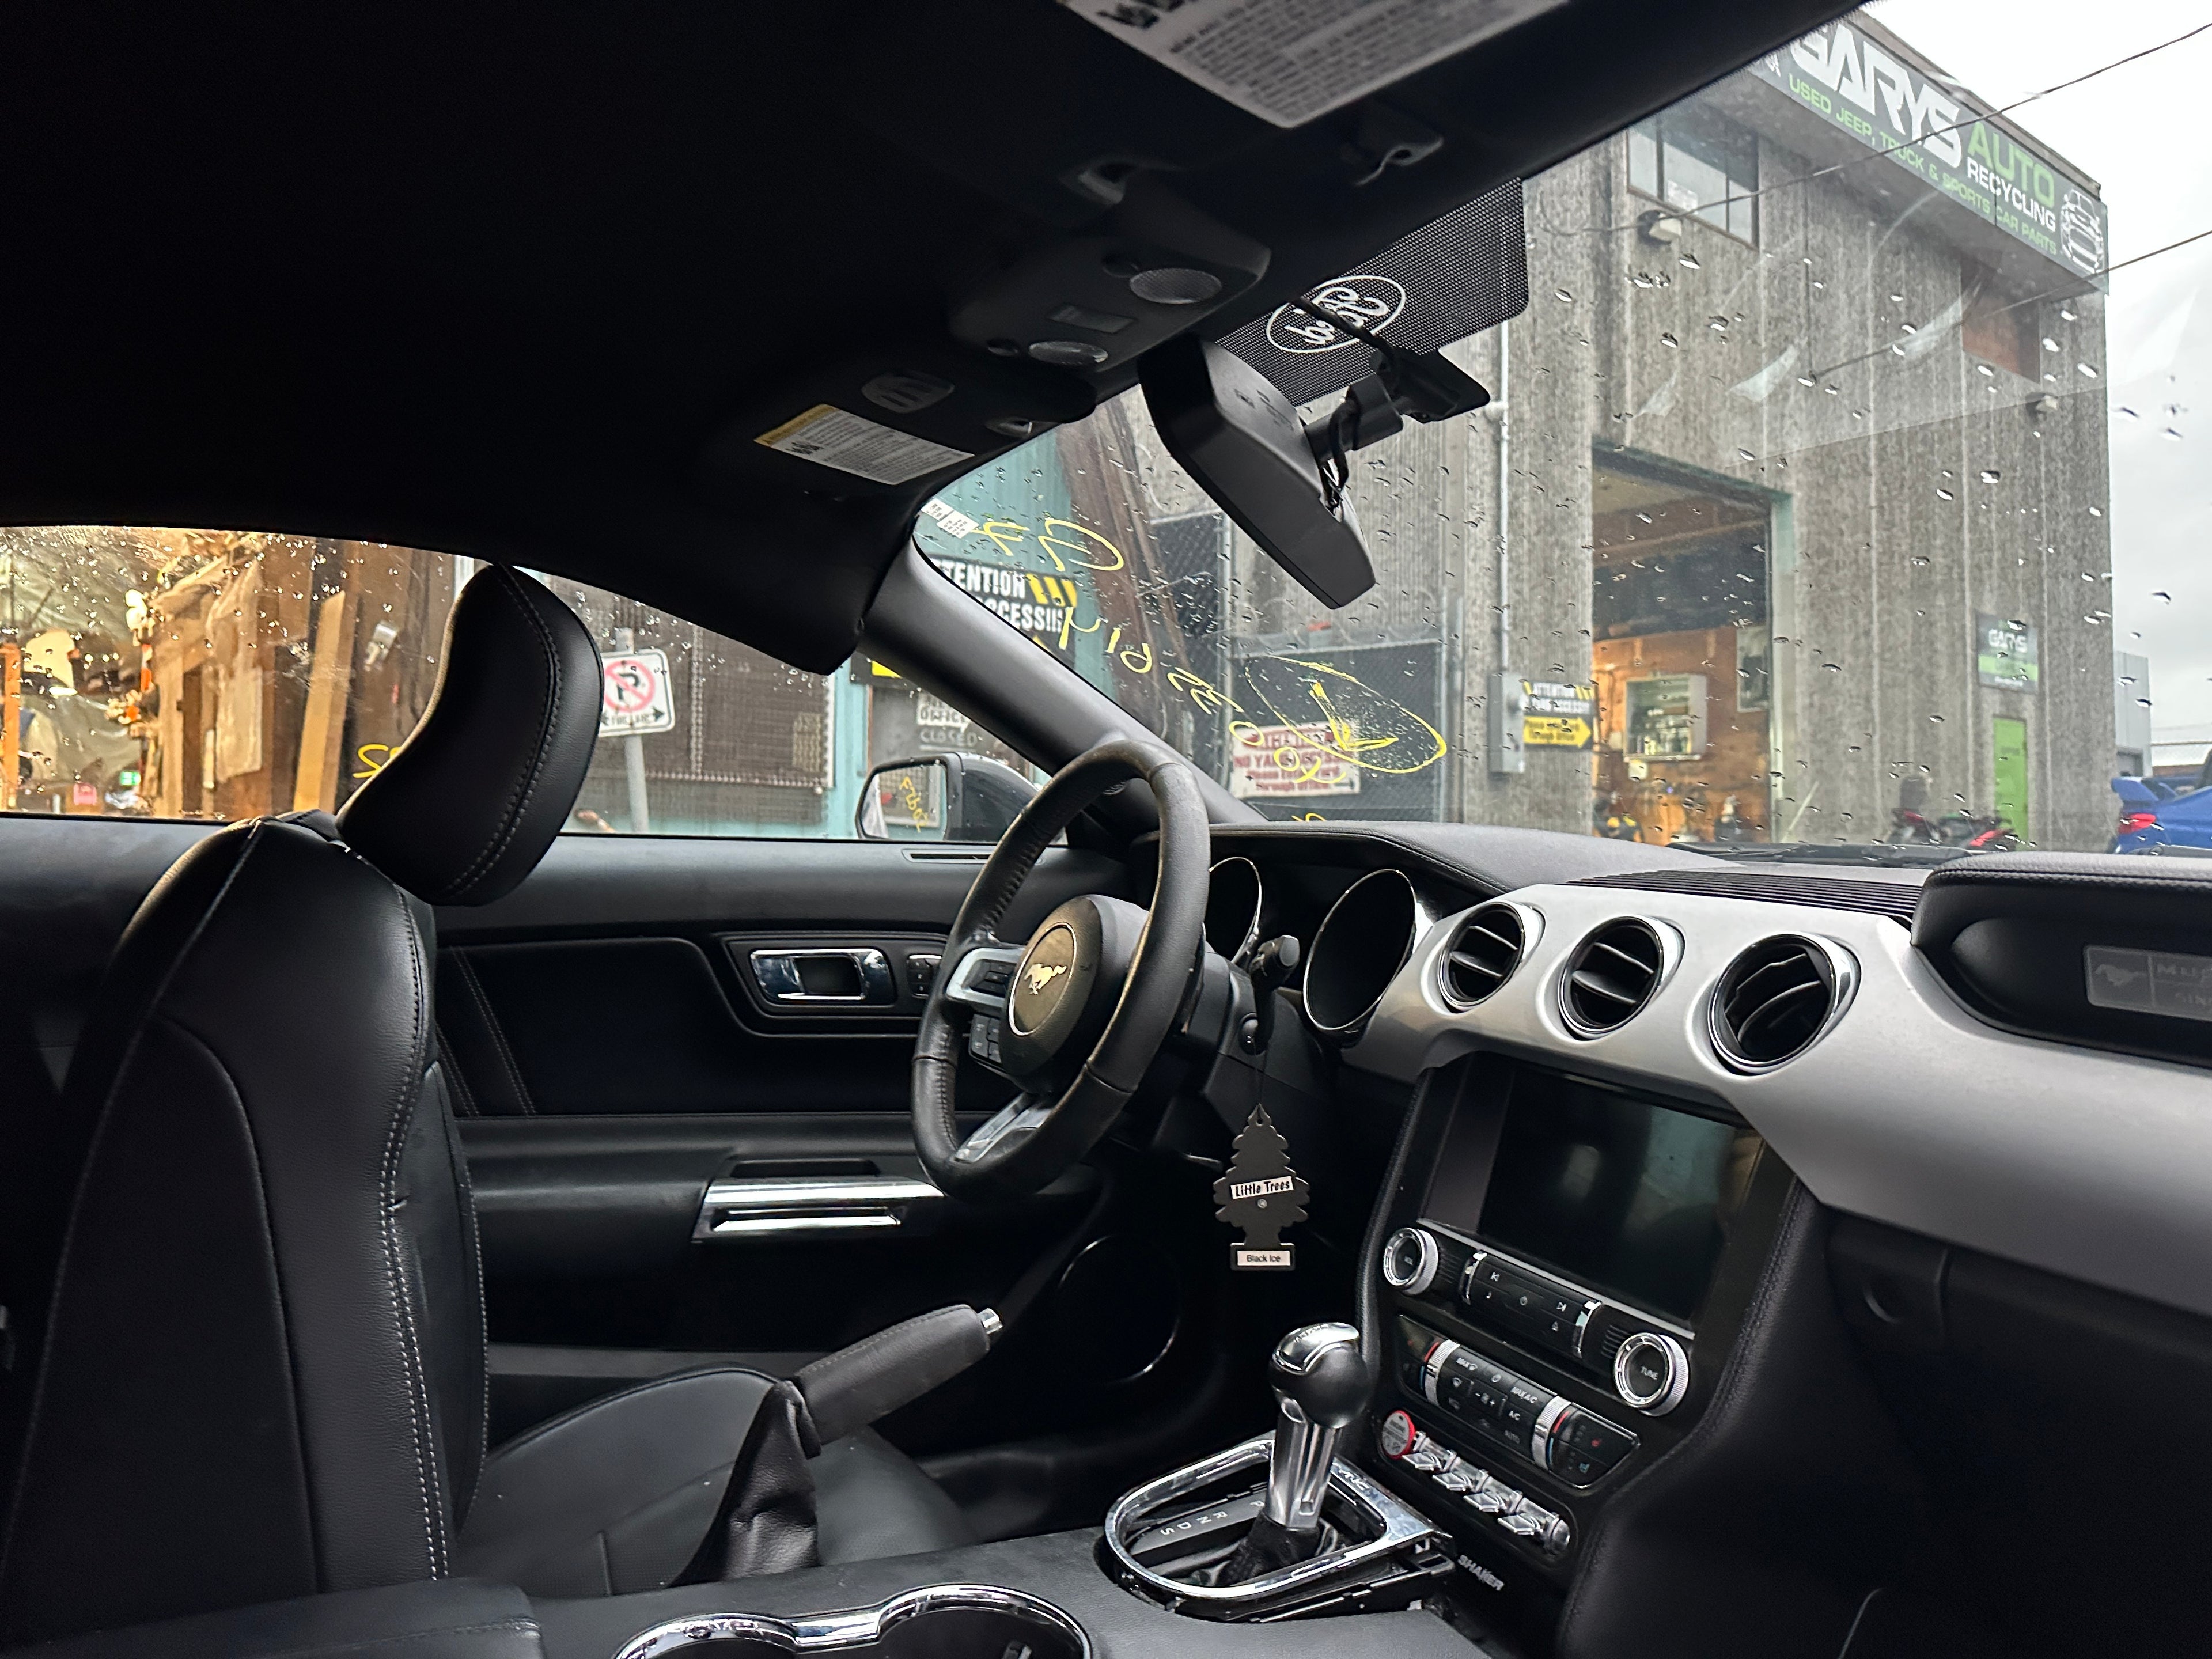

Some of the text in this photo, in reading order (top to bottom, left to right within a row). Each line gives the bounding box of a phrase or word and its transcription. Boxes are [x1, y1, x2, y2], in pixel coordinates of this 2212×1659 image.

[1790, 23, 1961, 168] GARYS
[1789, 73, 1831, 114] USED
[1880, 131, 1925, 173] TRUCK
[1929, 164, 1939, 181] &
[1942, 173, 1990, 214] SPORTS
[1995, 208, 2018, 231] CAR
[2022, 223, 2056, 255] PARTS
[1968, 122, 2055, 209] AUTO
[1967, 157, 2056, 232] RECYCLING
[920, 728, 978, 747] CLOSED
[1236, 1180, 1290, 1198] Little Trees
[1247, 1254, 1267, 1262] Black
[1640, 1366, 1659, 1380] TUNE
[1196, 1516, 1212, 1524] N
[1213, 1510, 1228, 1519] R
[1160, 1527, 1175, 1536] S
[1177, 1522, 1192, 1530] D
[1457, 1554, 1505, 1592] SHAKER
